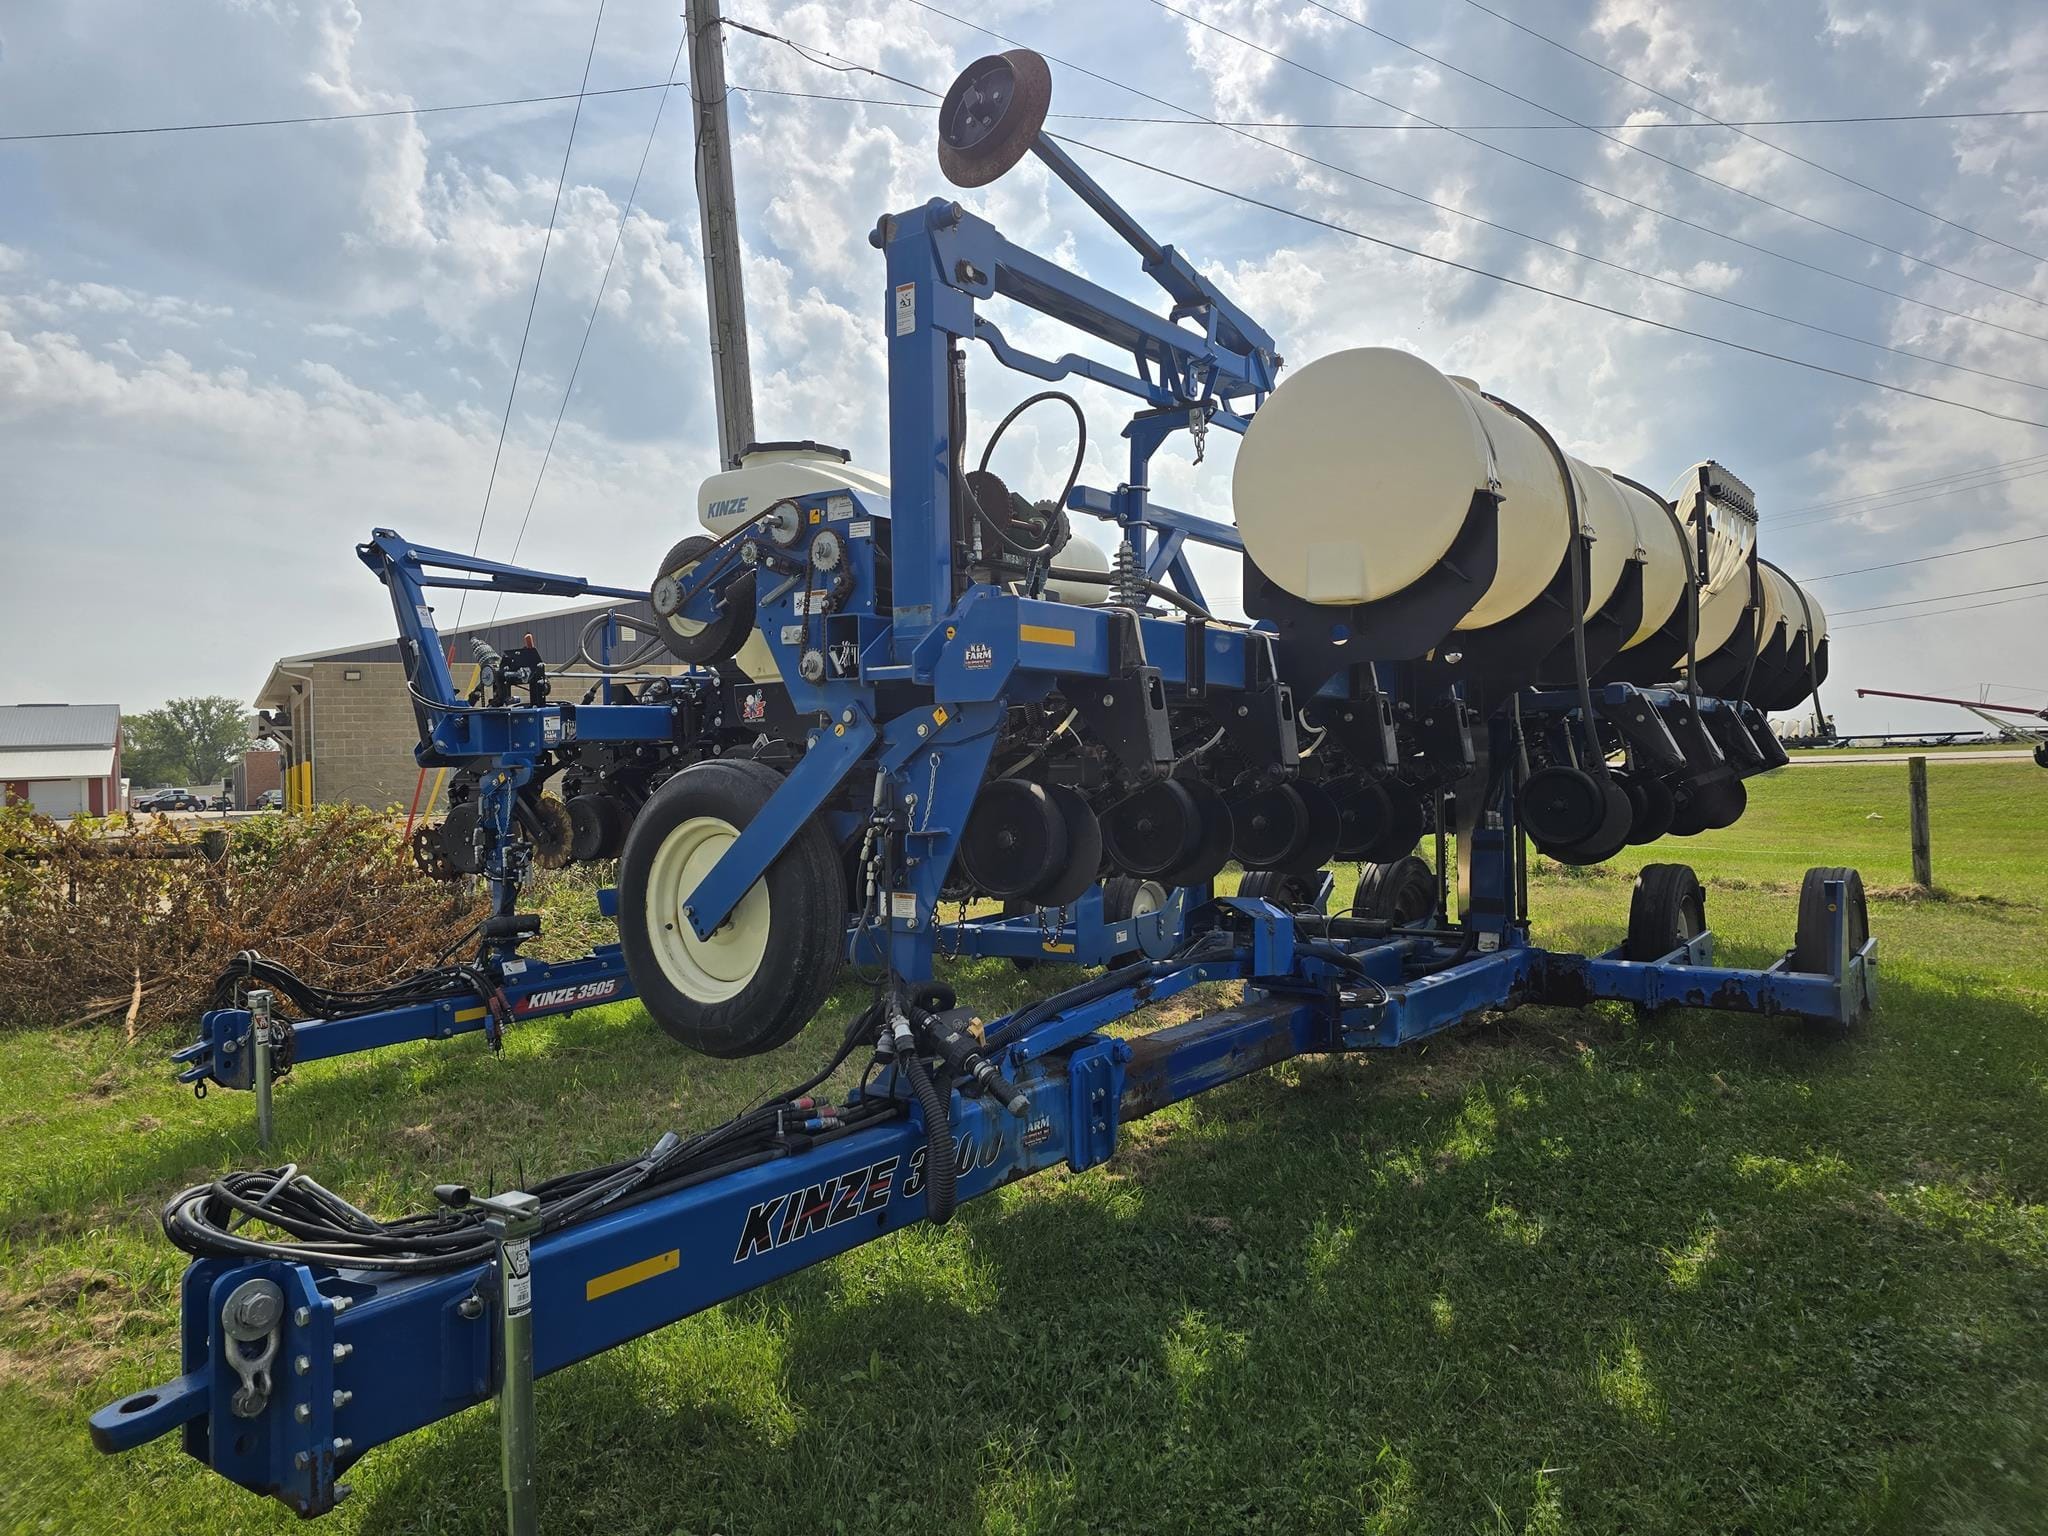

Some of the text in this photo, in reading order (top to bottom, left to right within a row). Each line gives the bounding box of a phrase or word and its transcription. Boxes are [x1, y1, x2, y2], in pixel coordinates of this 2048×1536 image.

[707, 496, 749, 519] KINZE
[965, 649, 992, 660] FARM
[528, 980, 615, 1009] KINZE 3505
[1024, 1114, 1051, 1133] ARM
[733, 1155, 900, 1264] KINZE
[902, 1130, 1004, 1198] 300
